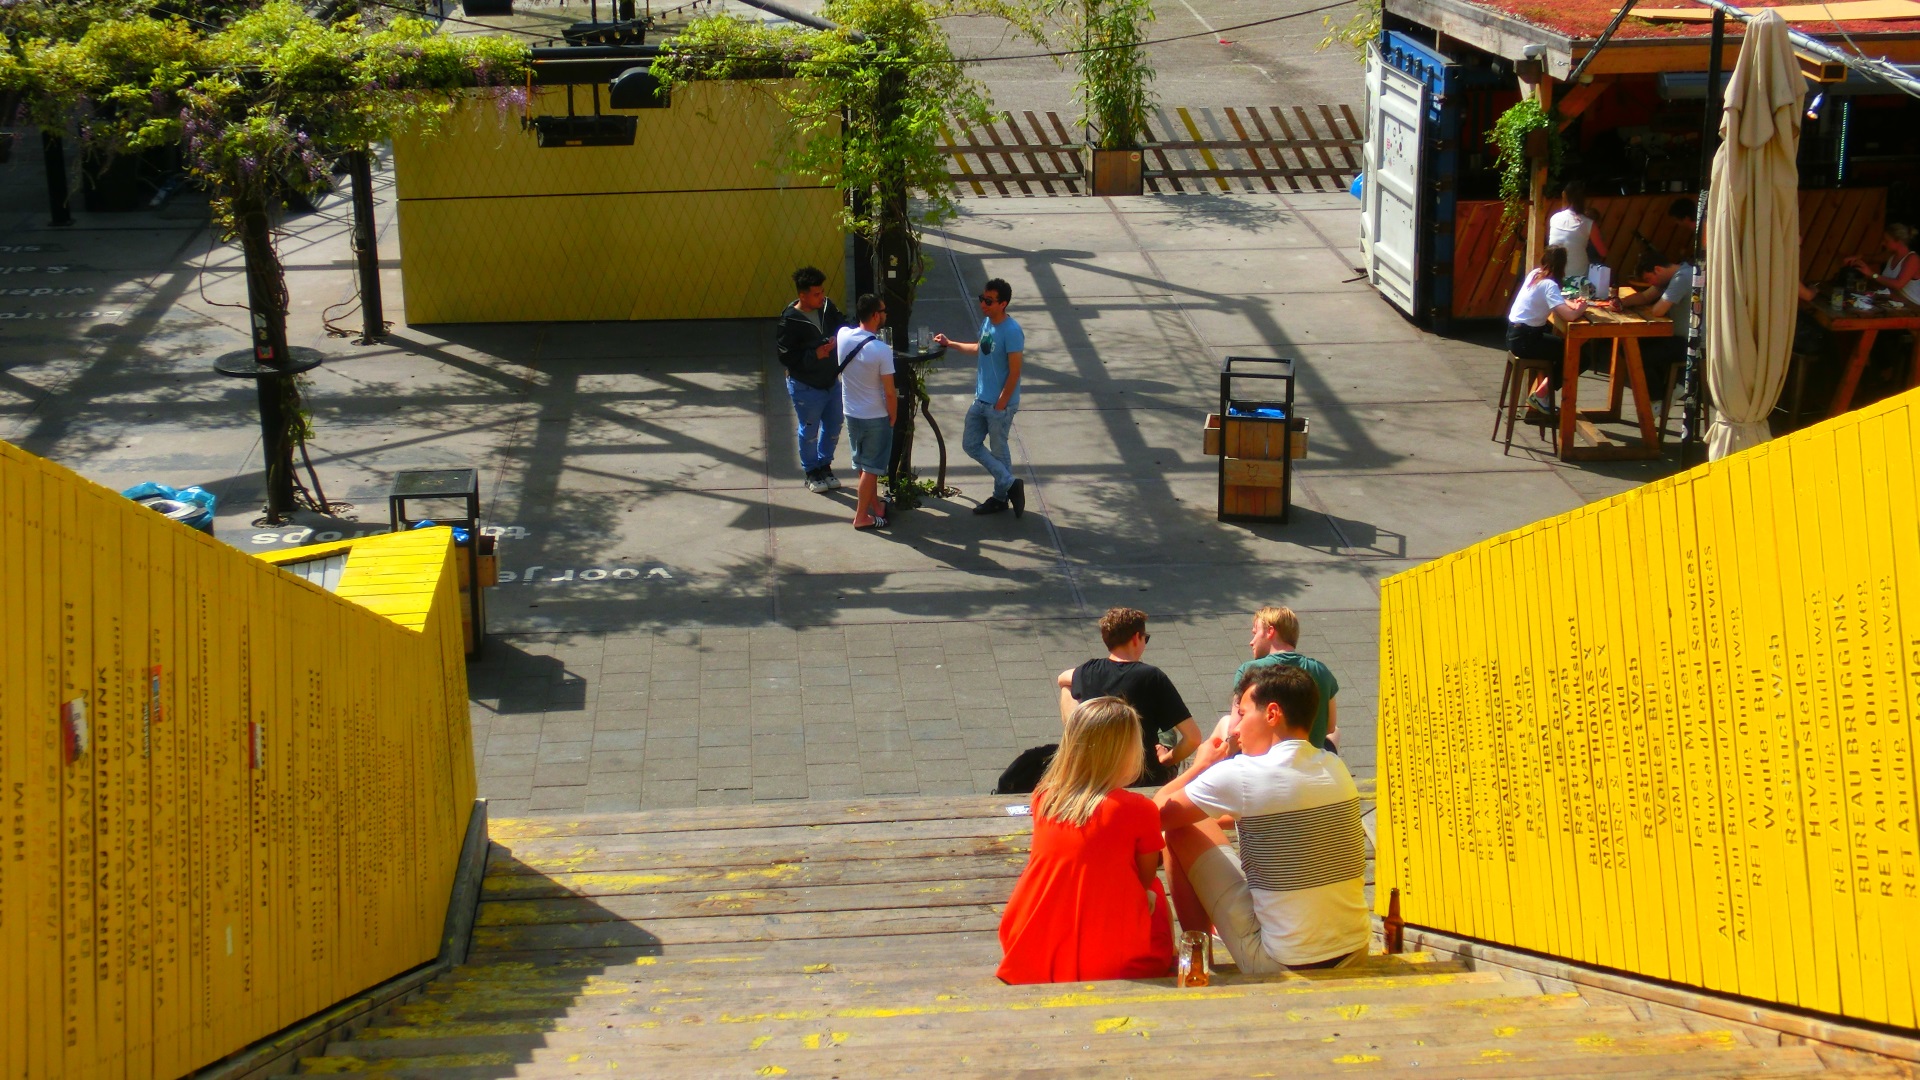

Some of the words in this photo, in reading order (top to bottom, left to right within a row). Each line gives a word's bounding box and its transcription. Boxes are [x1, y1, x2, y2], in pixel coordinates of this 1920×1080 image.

[551, 565, 674, 583] voor
[1685, 549, 1703, 650] Services
[1703, 545, 1721, 649] Services
[1584, 647, 1592, 660] X
[1597, 644, 1607, 656] X
[1629, 658, 1642, 714] Web
[1730, 607, 1751, 736] Onderweg
[1768, 634, 1785, 699] Web
[1811, 590, 1834, 729] Onderweg
[1833, 594, 1859, 755] BRUGGINK
[1856, 580, 1880, 726] Onderweg
[1879, 575, 1904, 724] Onderweg
[46, 655, 56, 750] Groot
[126, 668, 134, 757] VELDE
[1431, 712, 1439, 739] Bijl
[1453, 662, 1466, 753] MONIQUE
[1462, 659, 1476, 751] Onderweg
[1472, 657, 1486, 750] Onderweg
[1491, 659, 1507, 768] BRUGGINK
[1504, 699, 1514, 731] Bijl
[1514, 675, 1525, 724] Web
[1523, 666, 1538, 745] People
[1548, 669, 1561, 730] Graaf
[1561, 668, 1573, 720] Web
[1586, 670, 1602, 766] THOMAS
[1599, 666, 1617, 763] THOMAS
[1646, 683, 1659, 721] Bijl
[1660, 641, 1679, 775] architecten
[1677, 648, 1695, 750] Mutsert
[1751, 669, 1767, 712] Bijl
[97, 667, 108, 835] BRUGGINK
[1447, 690, 1459, 774] Nederland
[1531, 756, 1540, 787] for
[1541, 725, 1551, 773] HBM
[1555, 741, 1564, 766] de
[1579, 744, 1590, 784] van
[1616, 686, 1637, 821] zinnebeeld
[1795, 649, 1821, 837] Havensteder
[46, 765, 57, 803] de
[80, 689, 91, 901] URBANISN
[126, 770, 135, 806] DE
[1434, 752, 1444, 818] Wouter
[1470, 760, 1481, 819] Aardig
[1480, 759, 1491, 819] Aardig
[1508, 742, 1521, 819] Wouter
[1518, 732, 1534, 832] Restruct
[1558, 776, 1570, 832] Joost
[1566, 729, 1583, 834] Restruct
[1596, 776, 1605, 790] &
[1609, 775, 1619, 789] &
[1634, 724, 1653, 839] Restruct
[1650, 733, 1667, 825] Wouter
[1671, 786, 1684, 833] EGM
[1687, 763, 1703, 850] Jeroen
[1741, 747, 1759, 829] Aardig
[1756, 724, 1775, 829] Wouter
[1775, 711, 1798, 845] Restruct
[1823, 742, 1842, 832] Aardig
[1868, 739, 1889, 832] Aardig
[1892, 737, 1913, 833] Aardig
[13, 783, 24, 861] HBM
[127, 819, 135, 872] VAN
[1476, 829, 1484, 860] RET
[1486, 828, 1494, 860] RET
[1501, 778, 1516, 862] BUREAU
[1534, 798, 1546, 839] Pay
[1598, 803, 1612, 869] MARC
[1612, 802, 1627, 869] MARC
[1848, 770, 1872, 894] BUREAU
[1711, 845, 1729, 939] Adriaan
[1730, 847, 1749, 942] Adriaan
[1748, 840, 1762, 886] RET
[1832, 843, 1846, 894] RET
[1877, 845, 1893, 897] RET
[1900, 845, 1917, 898] RET
[80, 917, 91, 959] DE
[98, 851, 108, 980] BUREAU
[127, 883, 135, 966] MARK
[141, 923, 149, 971] RET
